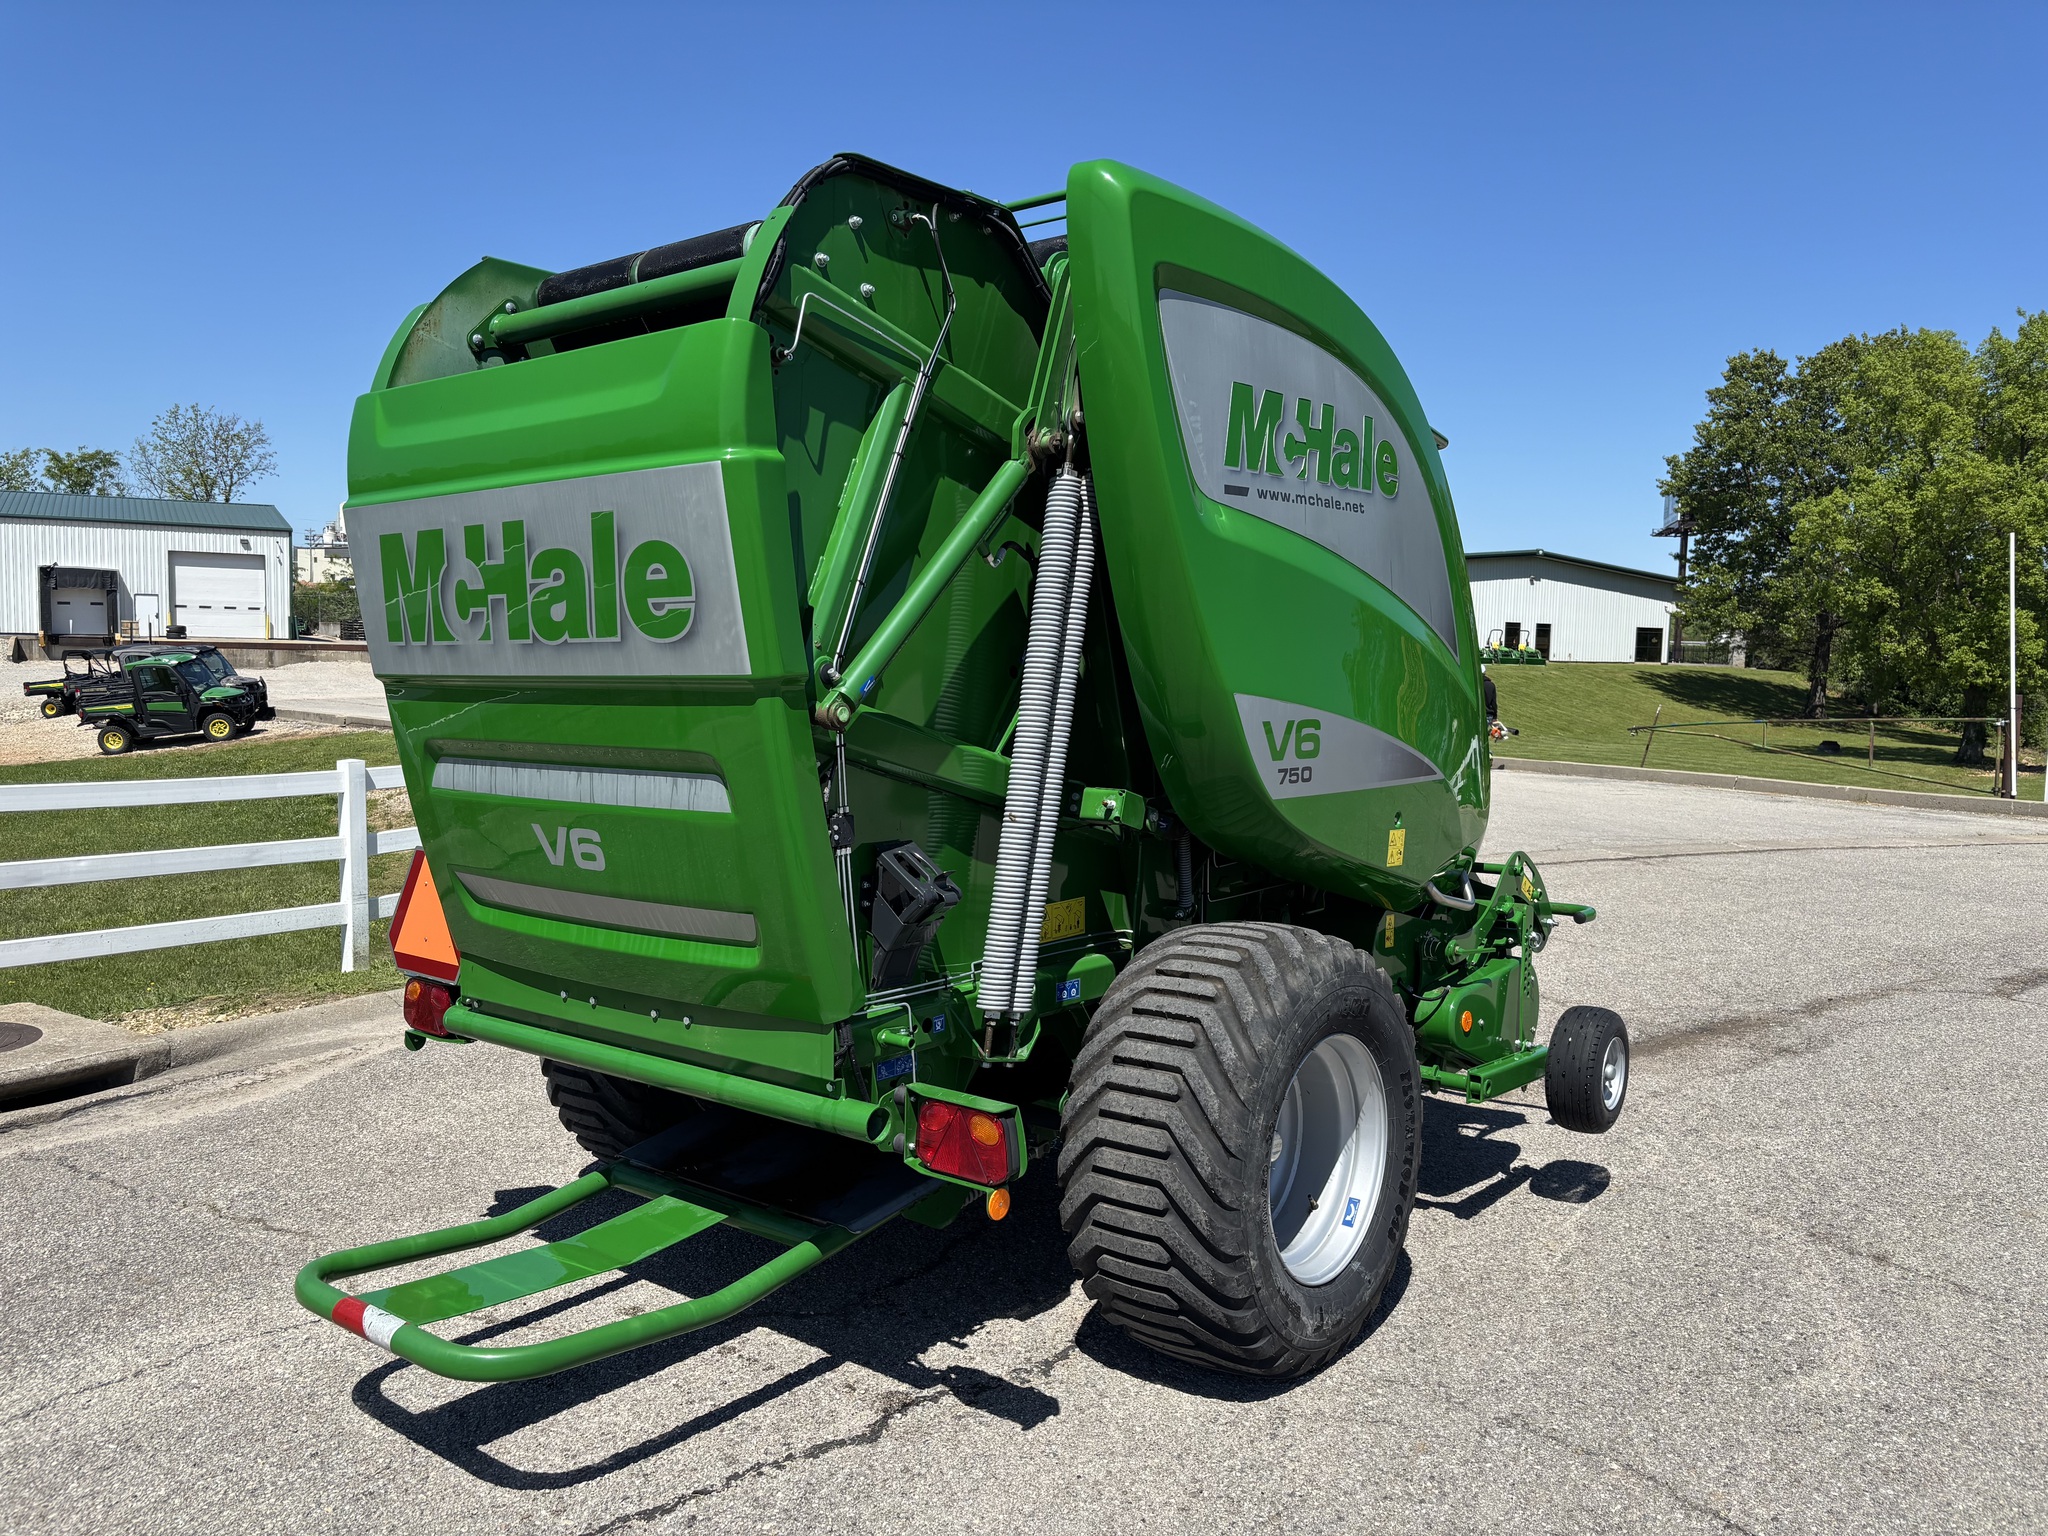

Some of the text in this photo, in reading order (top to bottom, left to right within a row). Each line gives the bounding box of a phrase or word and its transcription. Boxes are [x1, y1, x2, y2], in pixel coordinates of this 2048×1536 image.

[1257, 488, 1365, 514] www.mchale.net
[1262, 718, 1321, 762] V6
[1277, 766, 1313, 785] 750
[531, 823, 606, 872] V6
